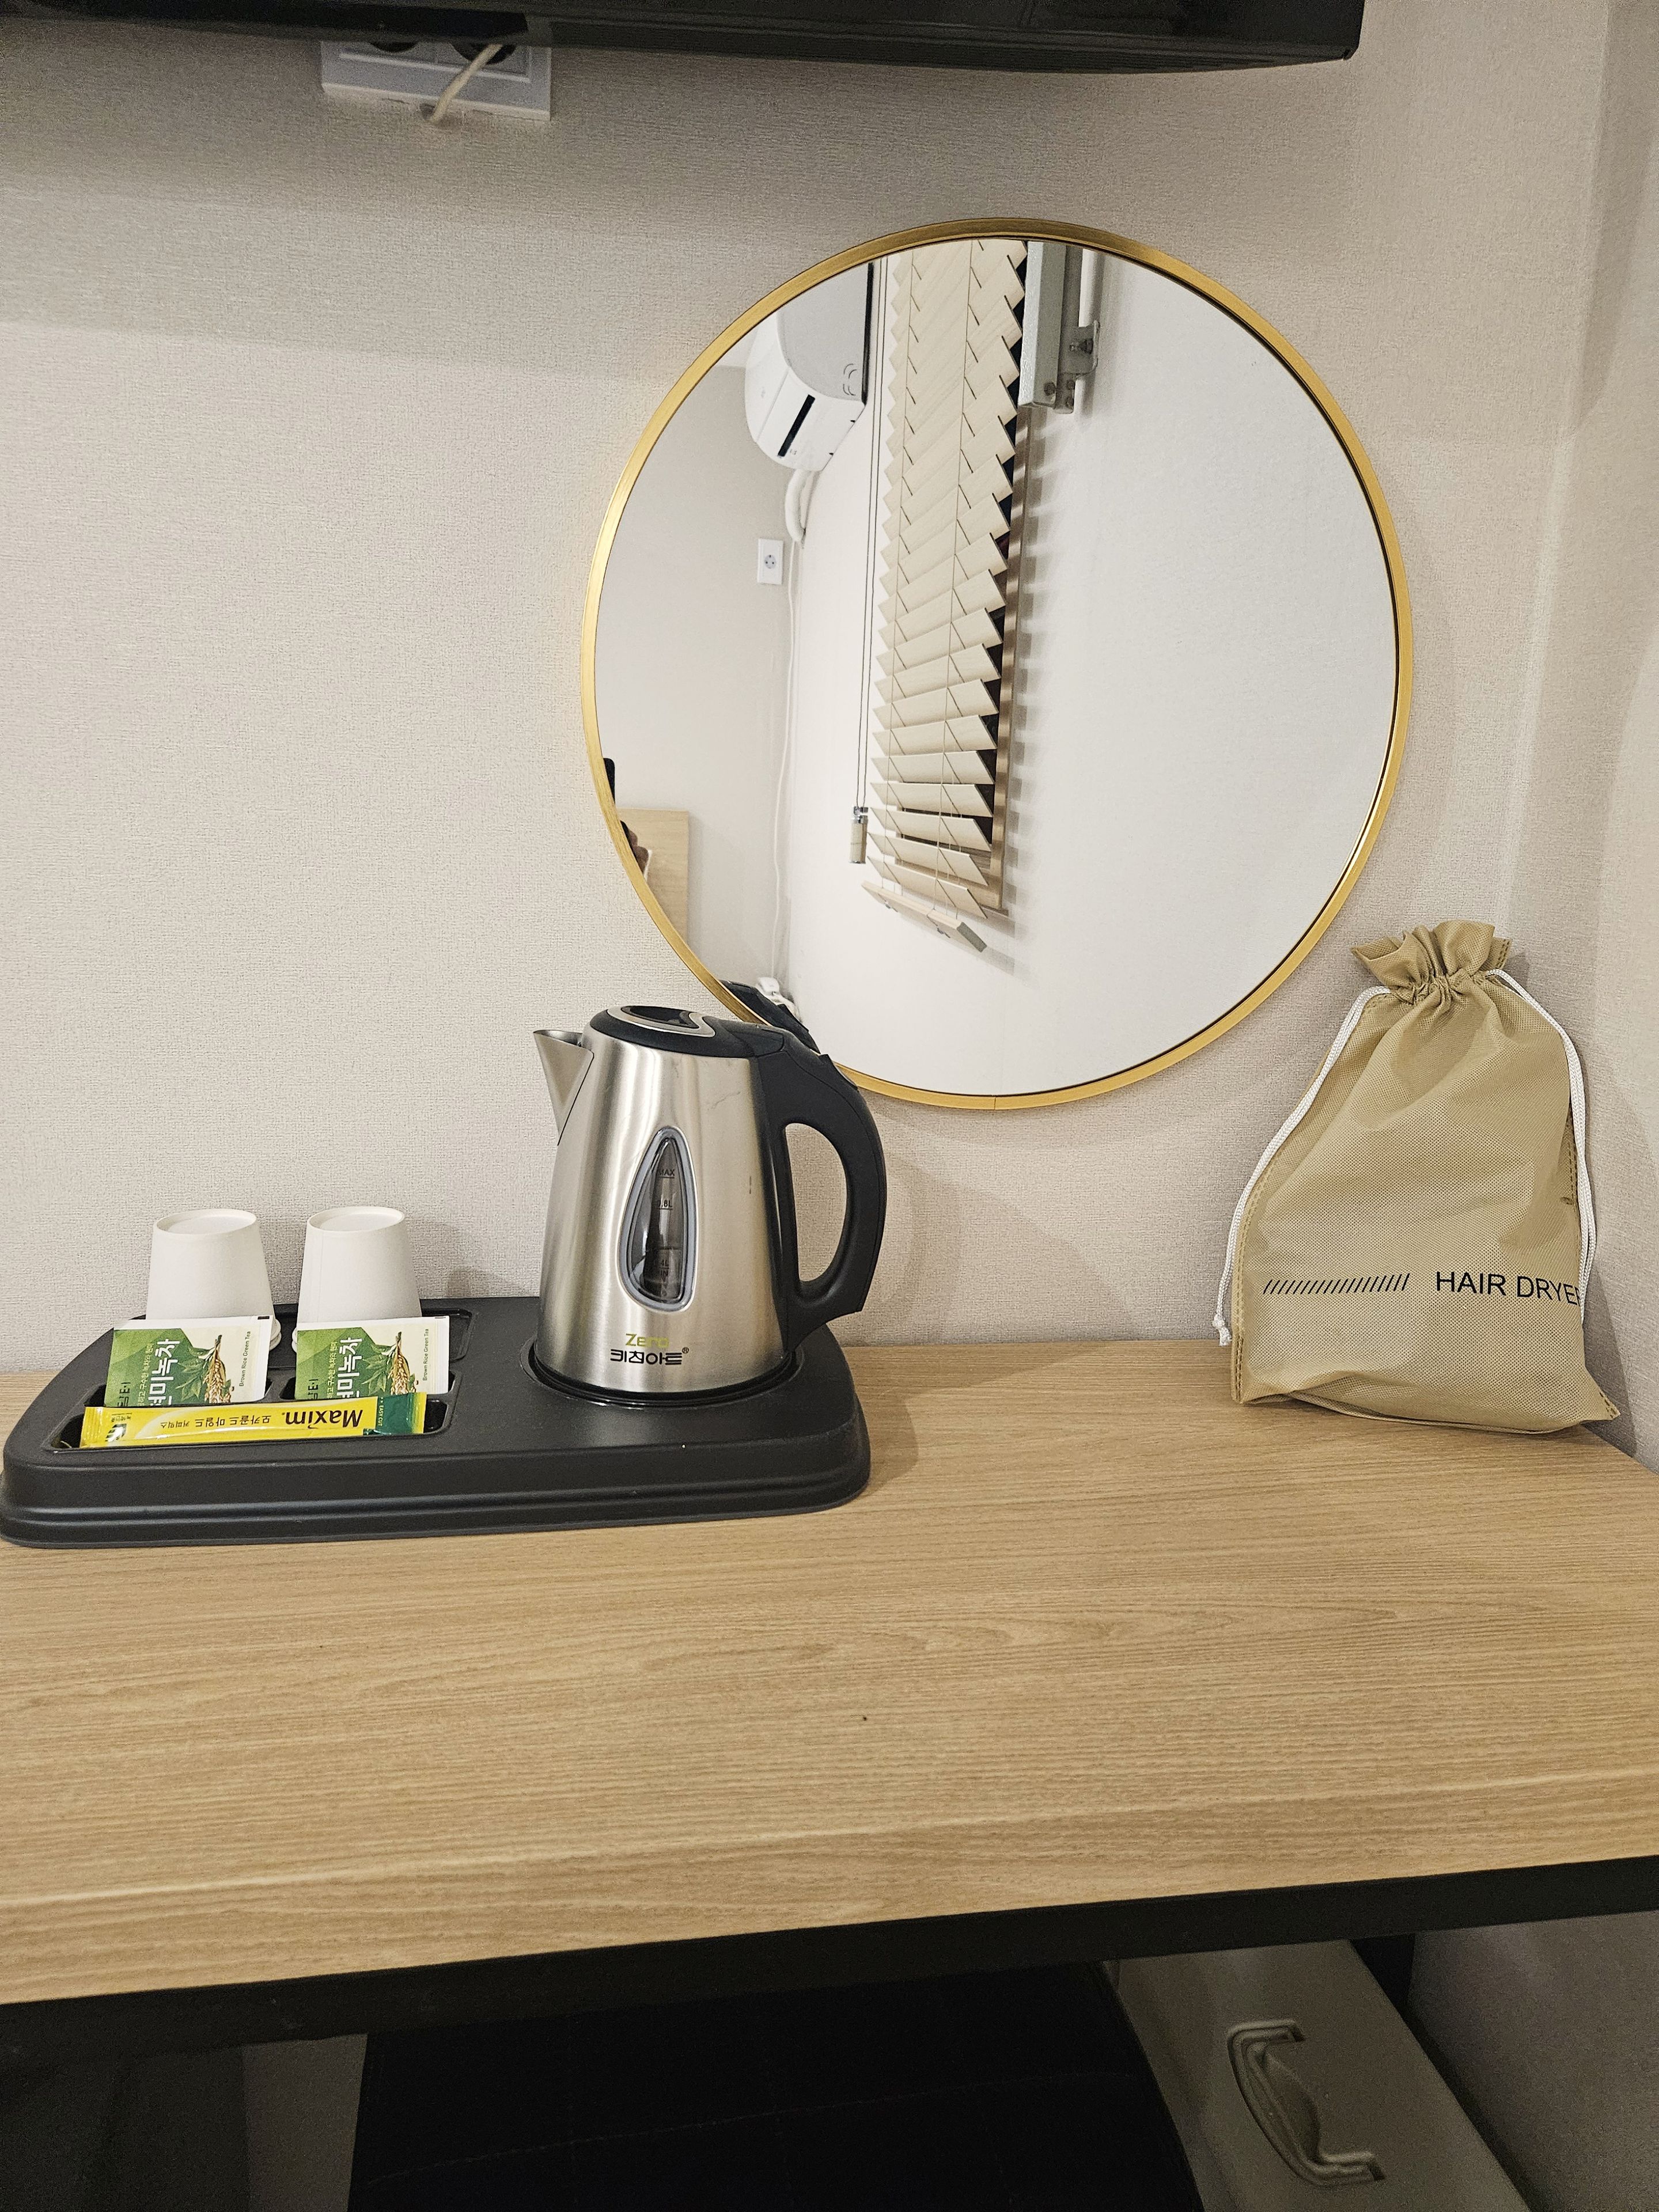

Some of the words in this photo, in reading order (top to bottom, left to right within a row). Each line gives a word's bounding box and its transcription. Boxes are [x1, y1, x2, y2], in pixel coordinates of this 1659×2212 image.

[1436, 1271, 1506, 1296] HAIR
[626, 1333, 669, 1347] Zero
[148, 1339, 180, 1406] 현미녹차
[160, 1420, 190, 1429] 커피믹스
[195, 1416, 226, 1427] 마일드
[229, 1415, 271, 1425] 모카골드
[285, 1410, 363, 1429] Maxim
